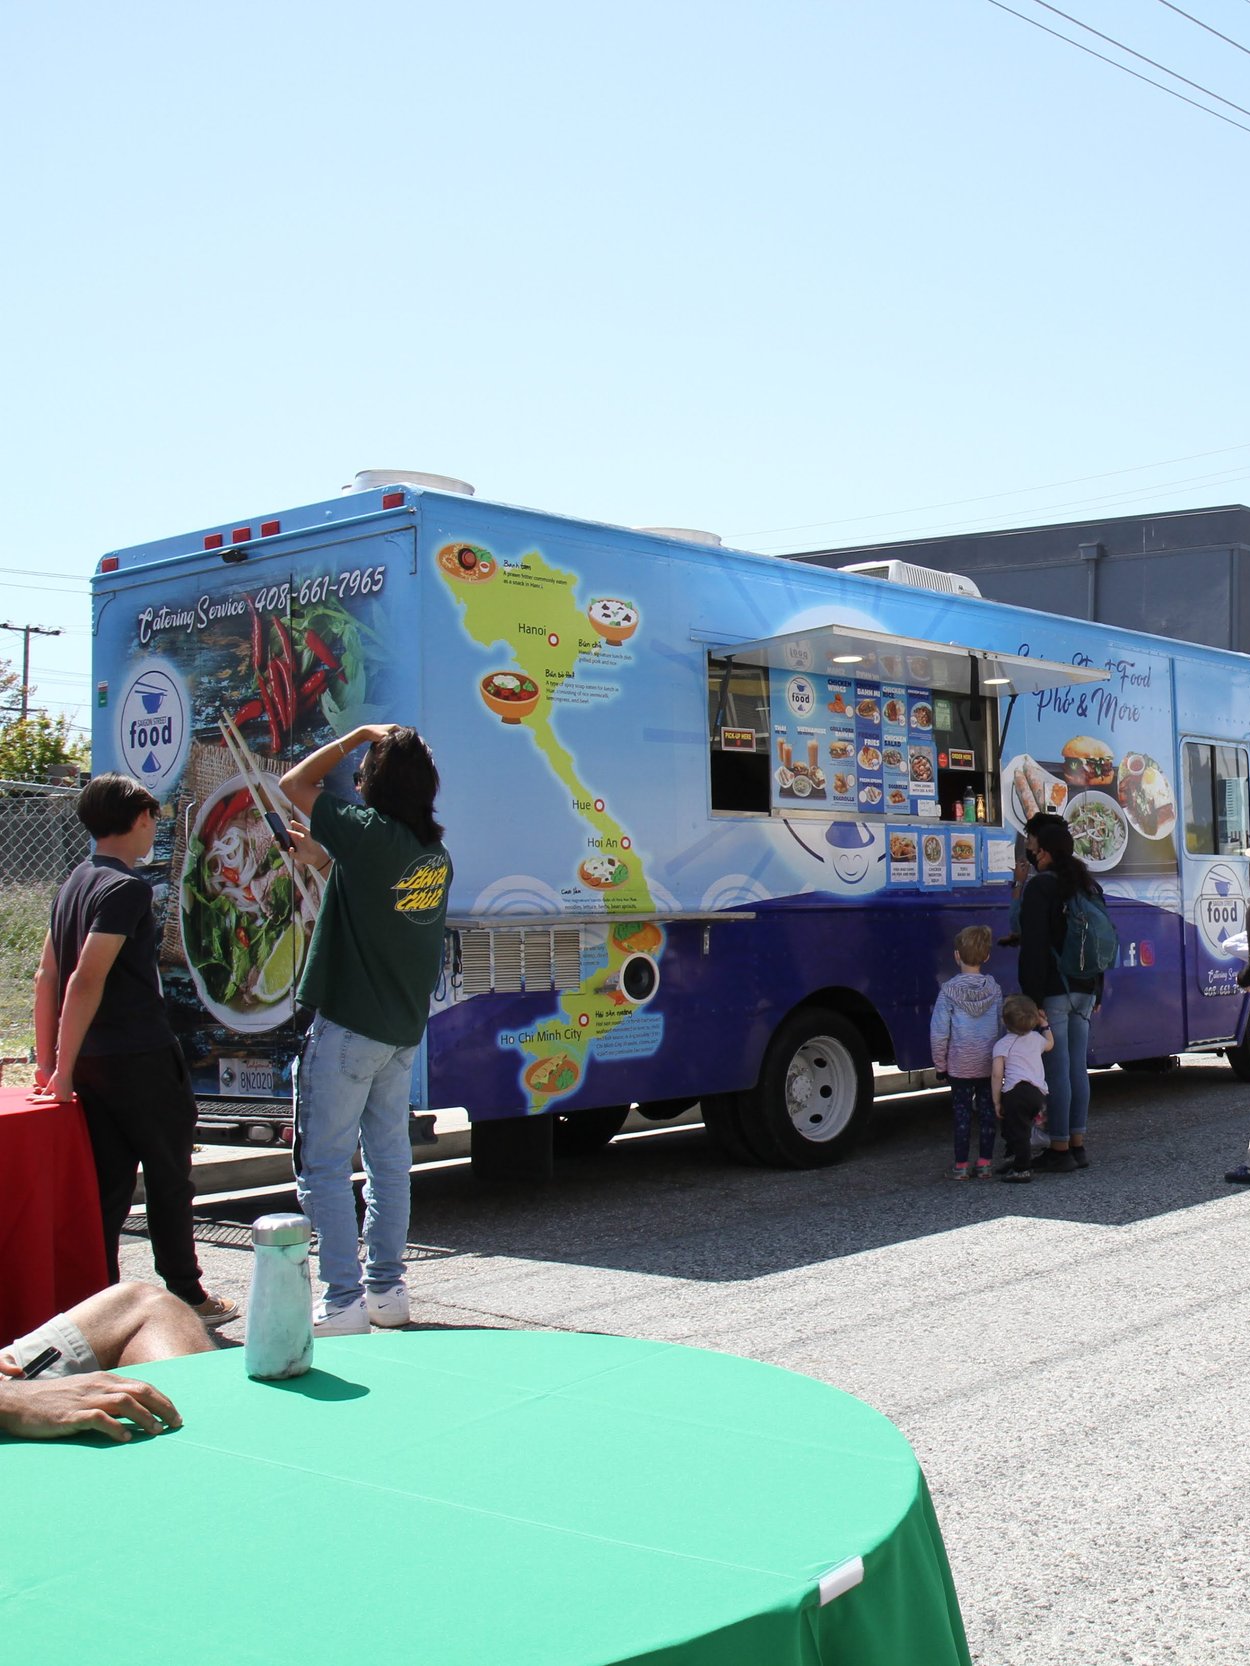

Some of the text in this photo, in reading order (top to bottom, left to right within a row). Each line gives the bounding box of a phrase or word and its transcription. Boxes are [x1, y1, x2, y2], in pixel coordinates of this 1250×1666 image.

[139, 565, 385, 644] Catering Service 408-661-7965
[518, 622, 547, 636] Hanoi
[1117, 660, 1151, 693] Food
[792, 692, 810, 703] food
[1076, 692, 1088, 718] &
[1091, 687, 1140, 733] More
[130, 716, 172, 749] food
[572, 799, 591, 810] Hue
[587, 837, 618, 848] Hoi An
[1207, 901, 1237, 923] food
[501, 1034, 515, 1045] Ho
[518, 1031, 534, 1043] Chi
[537, 1029, 561, 1042] Minh
[564, 1028, 583, 1042] City
[240, 1071, 273, 1090] 8N2020
